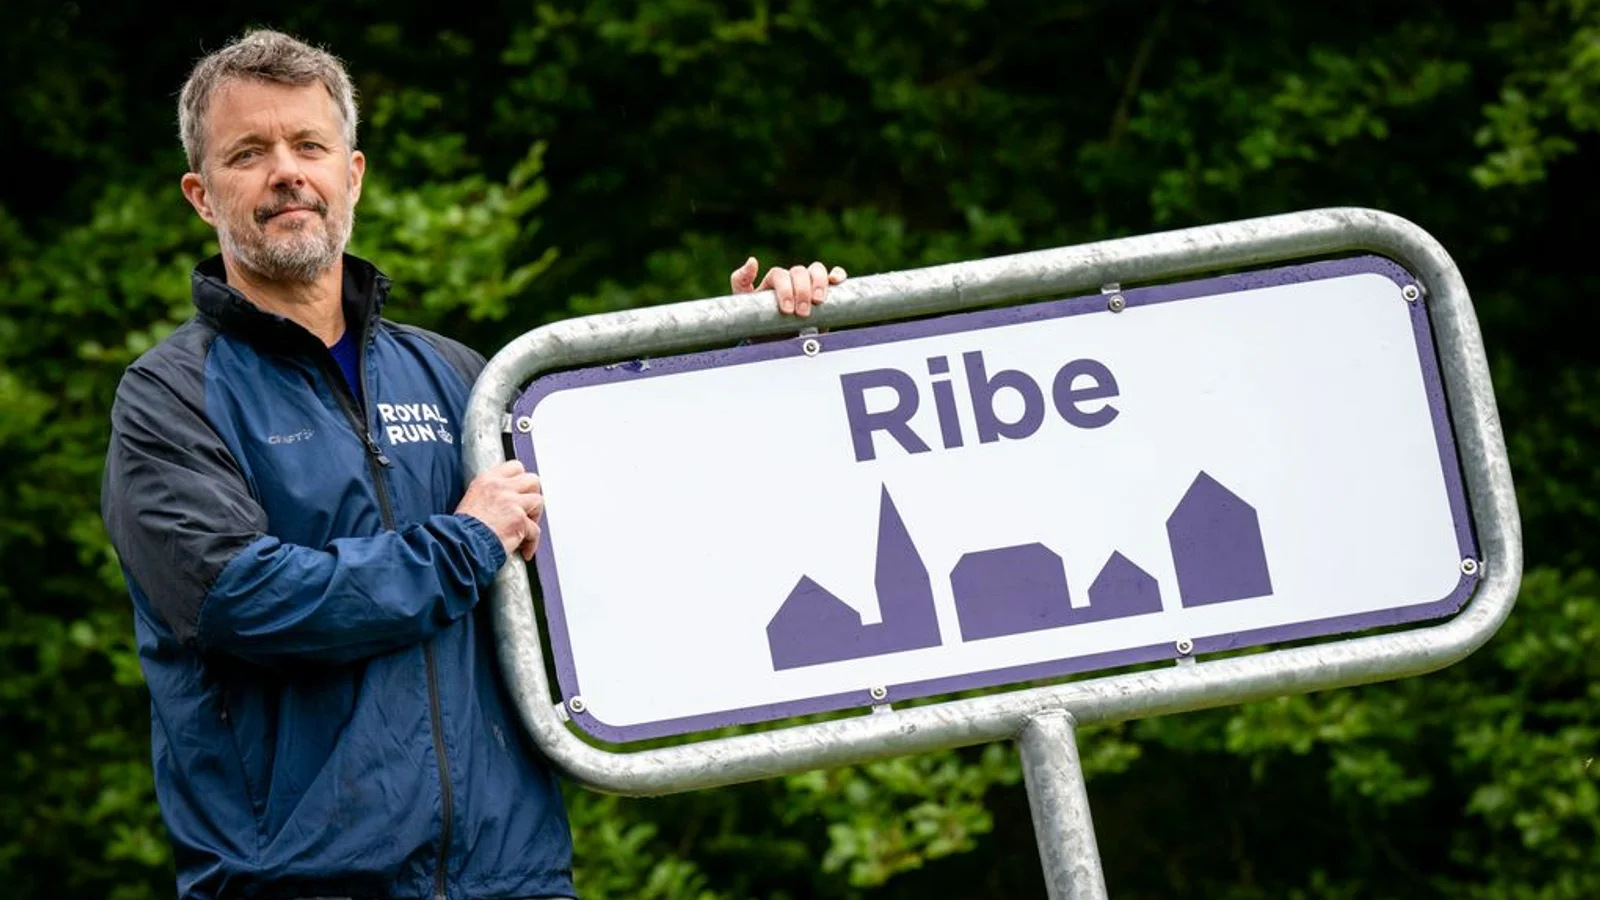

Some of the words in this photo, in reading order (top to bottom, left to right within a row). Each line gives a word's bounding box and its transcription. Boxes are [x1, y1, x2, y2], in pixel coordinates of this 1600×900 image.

[377, 403, 448, 424] ROYAL
[839, 350, 1120, 462] Ribe
[386, 424, 437, 445] RUN
